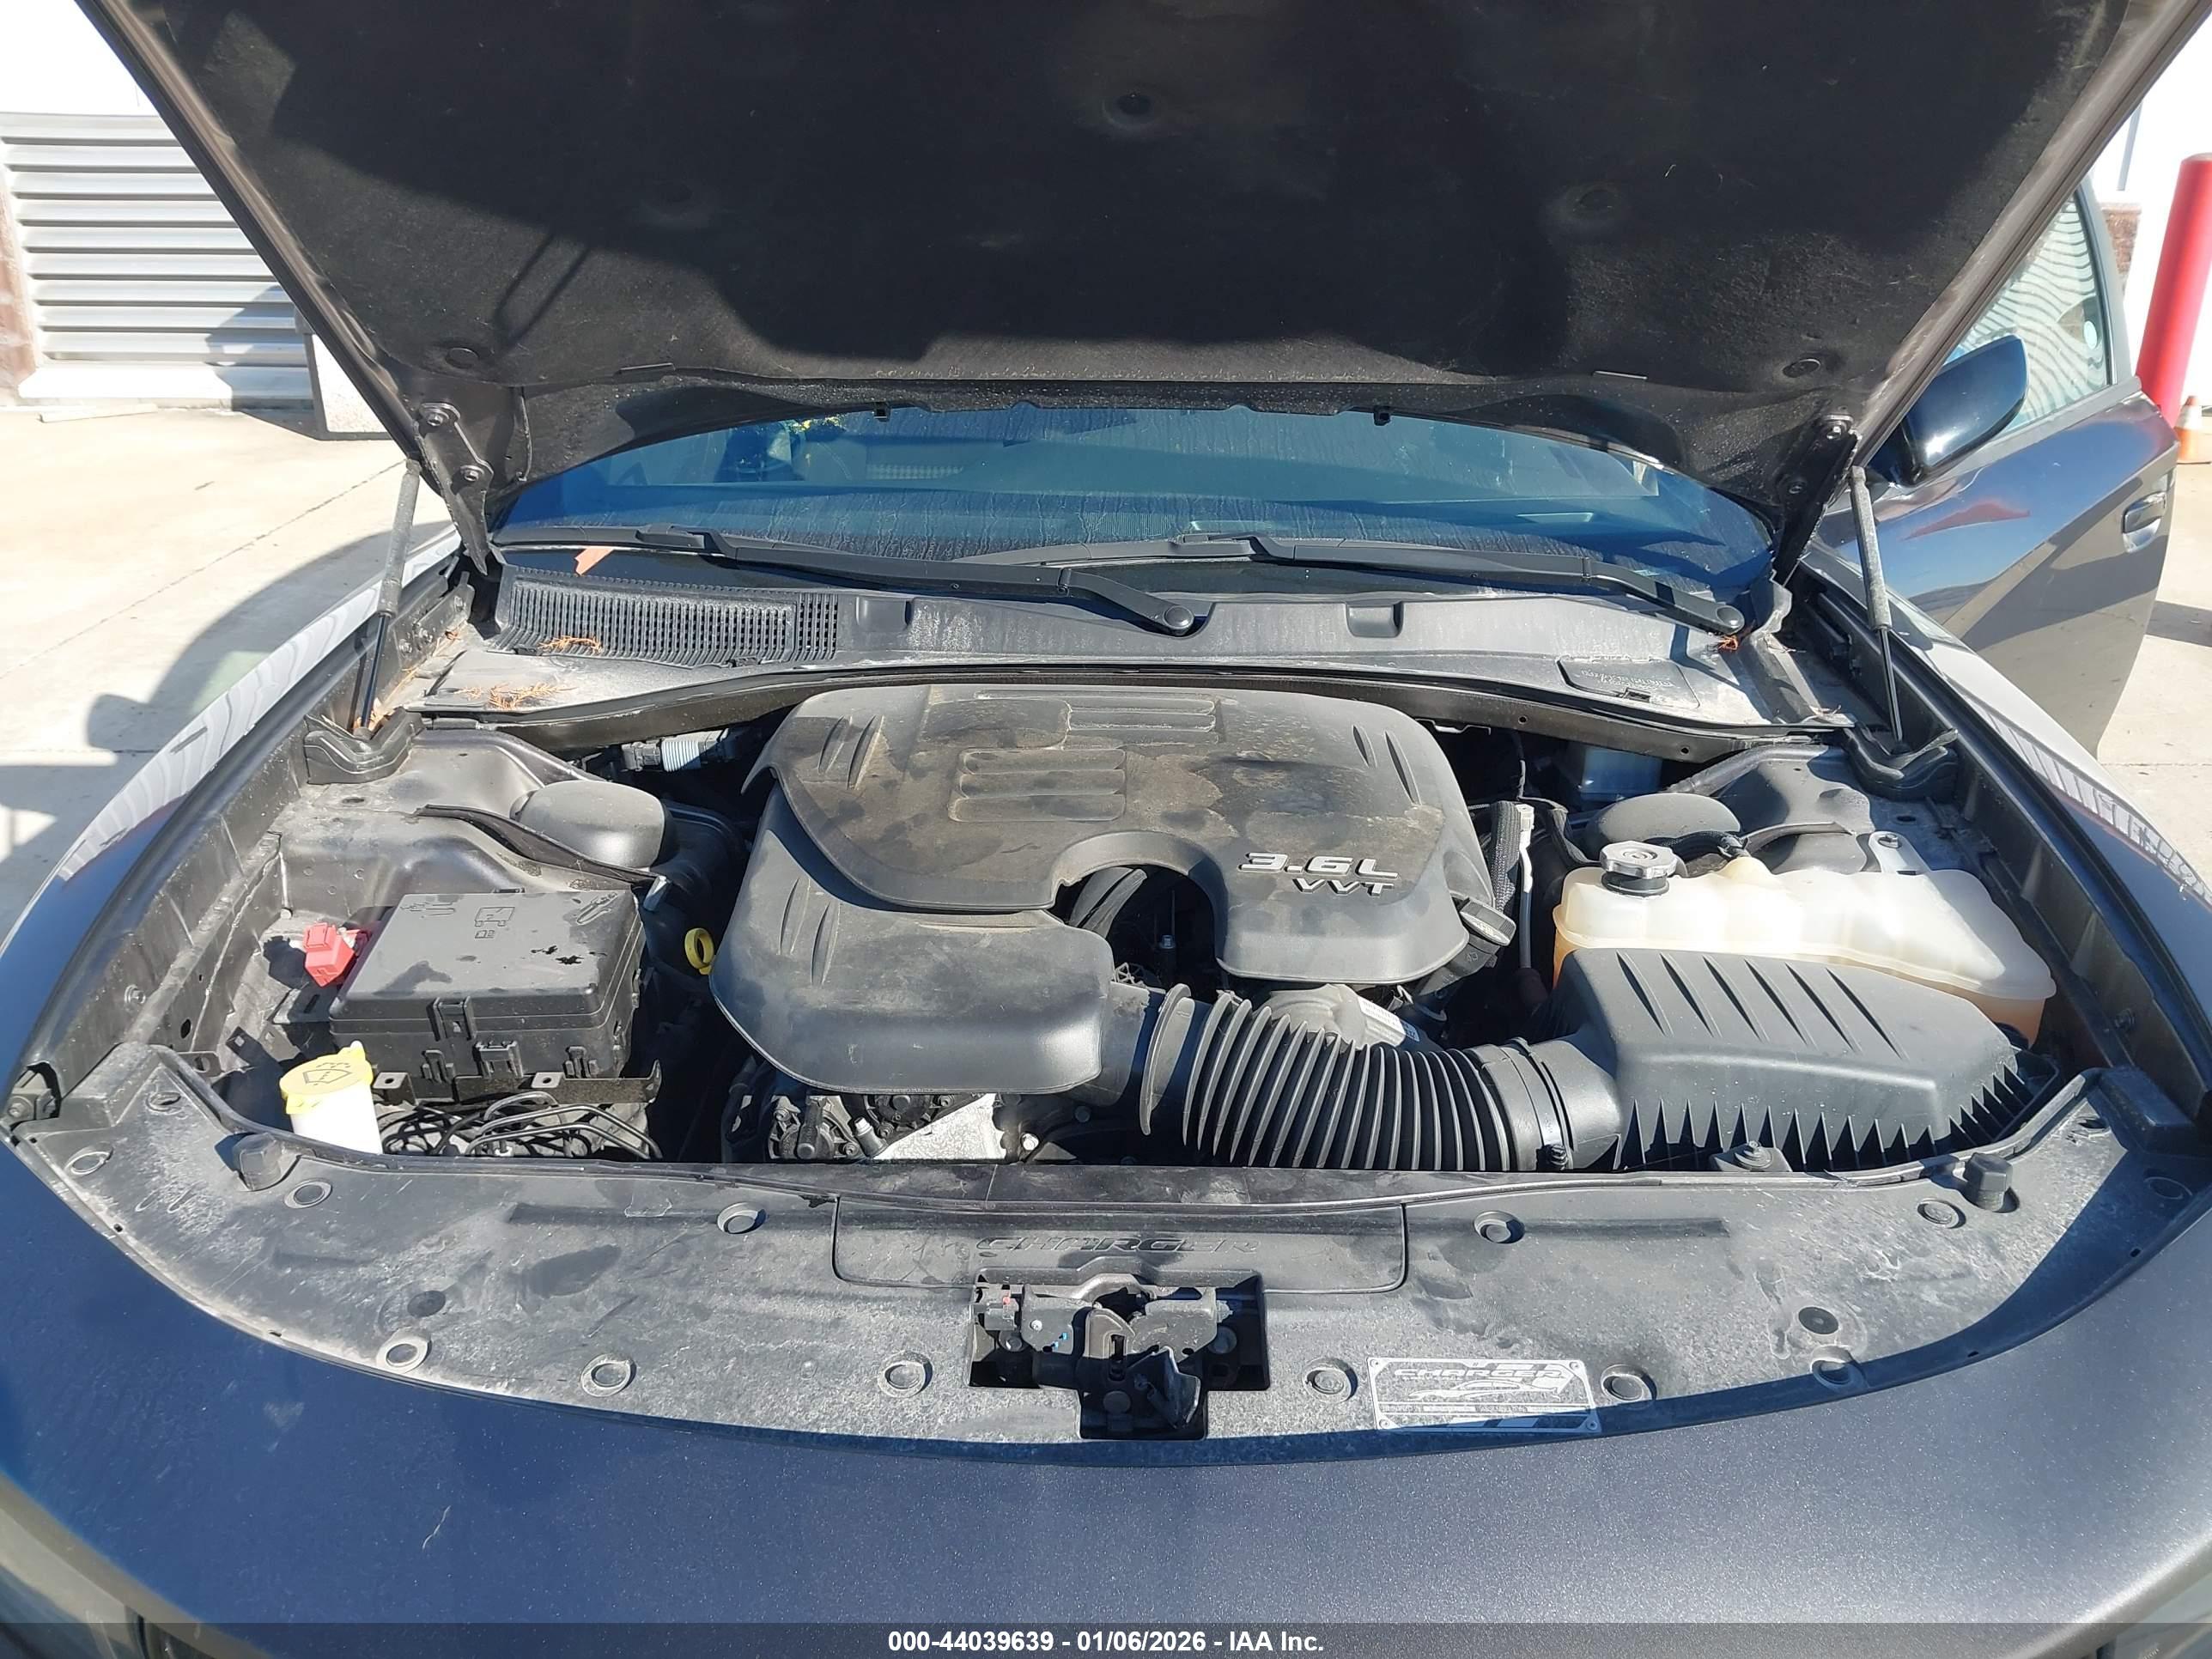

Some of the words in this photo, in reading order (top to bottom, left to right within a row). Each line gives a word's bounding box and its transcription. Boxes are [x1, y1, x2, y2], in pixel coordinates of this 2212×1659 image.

[1237, 852, 1400, 879] 3.6L
[1292, 878, 1395, 897] VVT
[975, 1236, 1261, 1254] CHARGER
[1394, 1368, 1562, 1379] CHARGER
